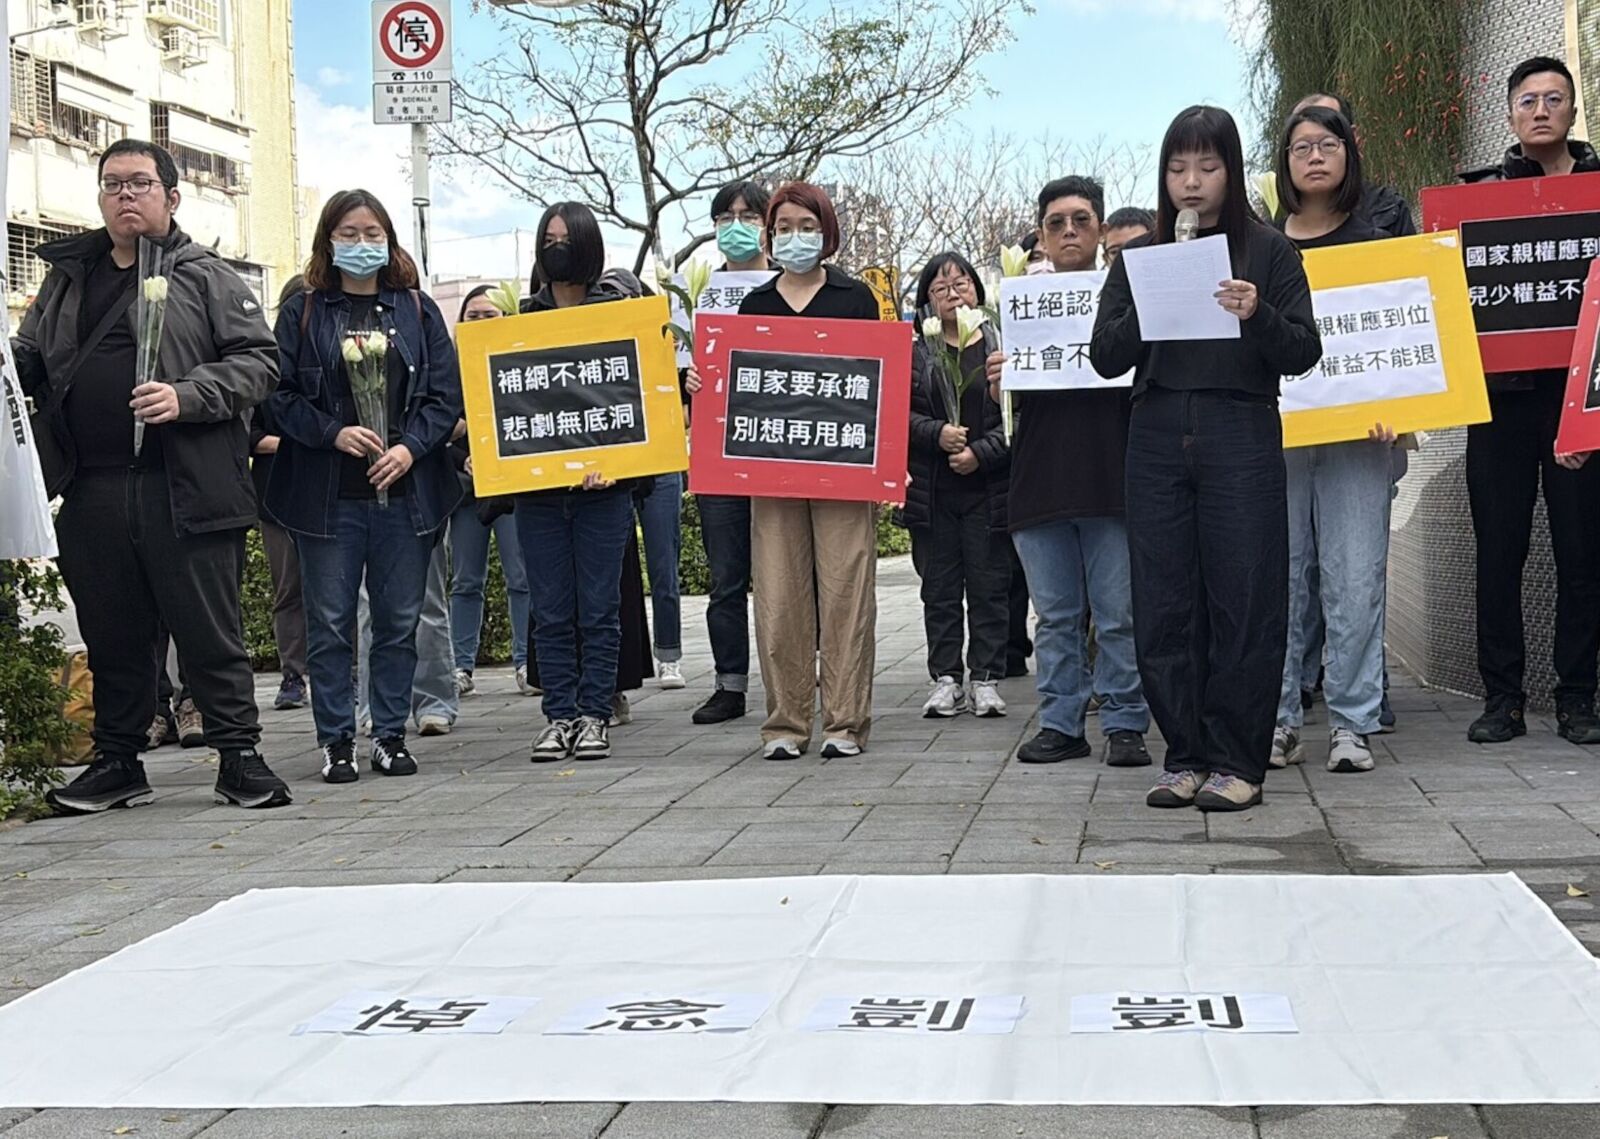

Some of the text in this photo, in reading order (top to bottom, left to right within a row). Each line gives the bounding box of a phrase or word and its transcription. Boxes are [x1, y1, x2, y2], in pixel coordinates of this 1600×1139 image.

[394, 17, 429, 53] 停
[413, 71, 434, 80] 110
[1008, 289, 1101, 321] 杜絕認
[1468, 278, 1588, 307] 兒少權益不
[497, 355, 630, 394] 補網不補洞
[1284, 343, 1438, 383] 權益不能退
[736, 366, 870, 401] 國家要承擔
[502, 403, 635, 441] 悲劇無底洞
[732, 415, 867, 449] 別想再甩鍋
